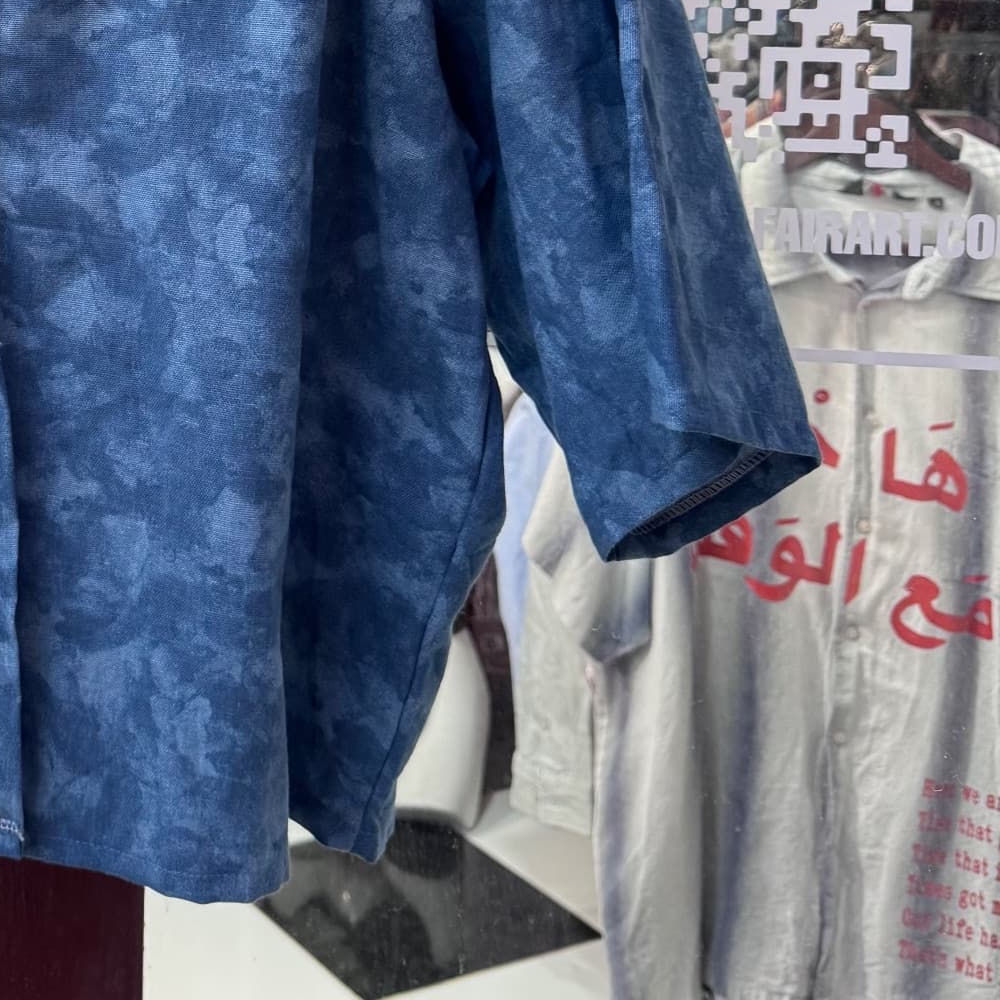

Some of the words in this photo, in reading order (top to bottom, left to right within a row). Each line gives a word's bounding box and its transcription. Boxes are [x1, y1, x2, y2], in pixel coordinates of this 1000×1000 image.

[752, 207, 1000, 261] FAIRART.CO
[957, 888, 985, 910] got
[955, 955, 994, 983] what
